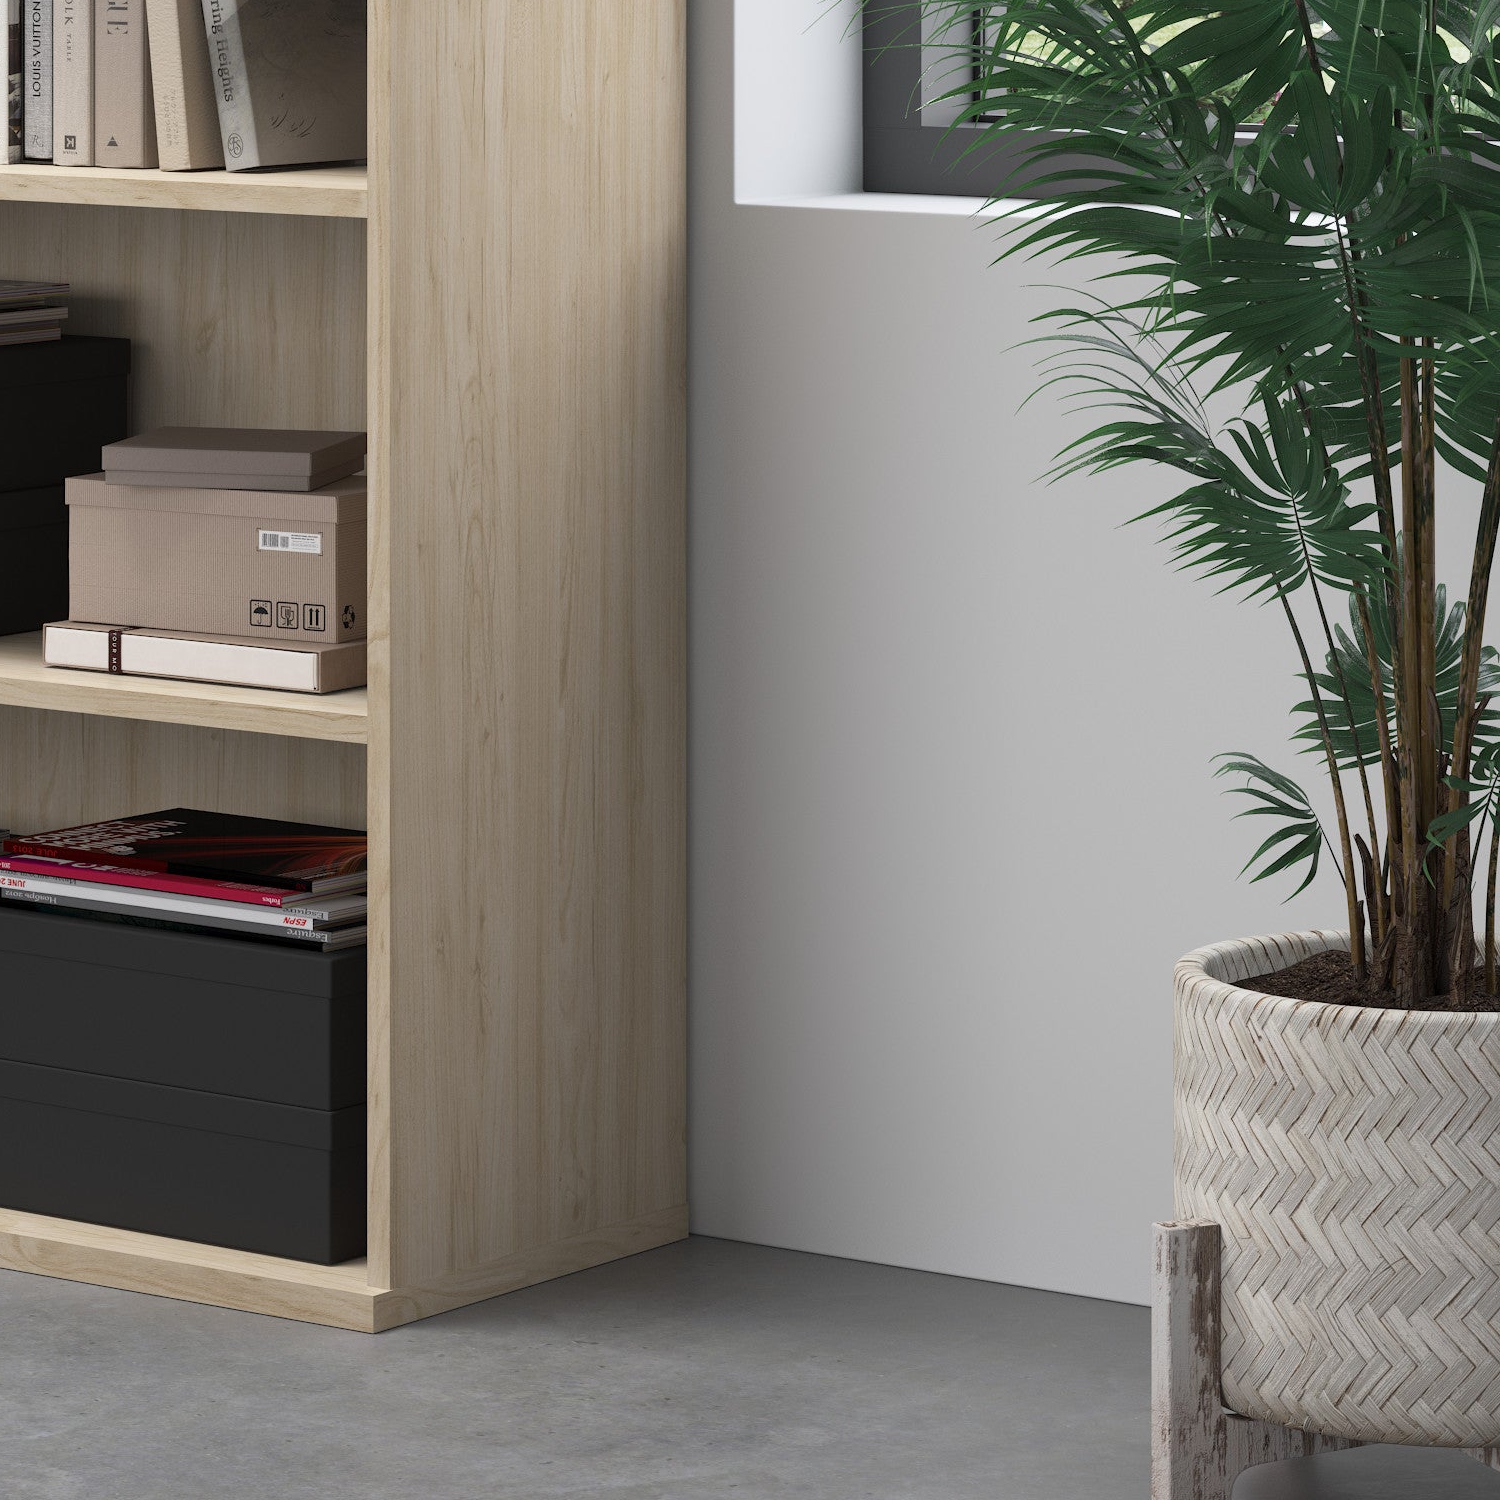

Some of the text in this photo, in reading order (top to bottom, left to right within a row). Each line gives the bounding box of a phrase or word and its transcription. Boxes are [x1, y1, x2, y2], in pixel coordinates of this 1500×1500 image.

[32, 1, 42, 57] VUITTON
[215, 40, 235, 103] Heights
[32, 60, 42, 98] LOUIS
[12, 844, 34, 855] 2013
[7, 878, 27, 888] JUNE
[262, 896, 281, 906] Forbes
[282, 907, 325, 920] Esquire
[283, 916, 308, 927] ESPN
[286, 928, 329, 943] Esquire
